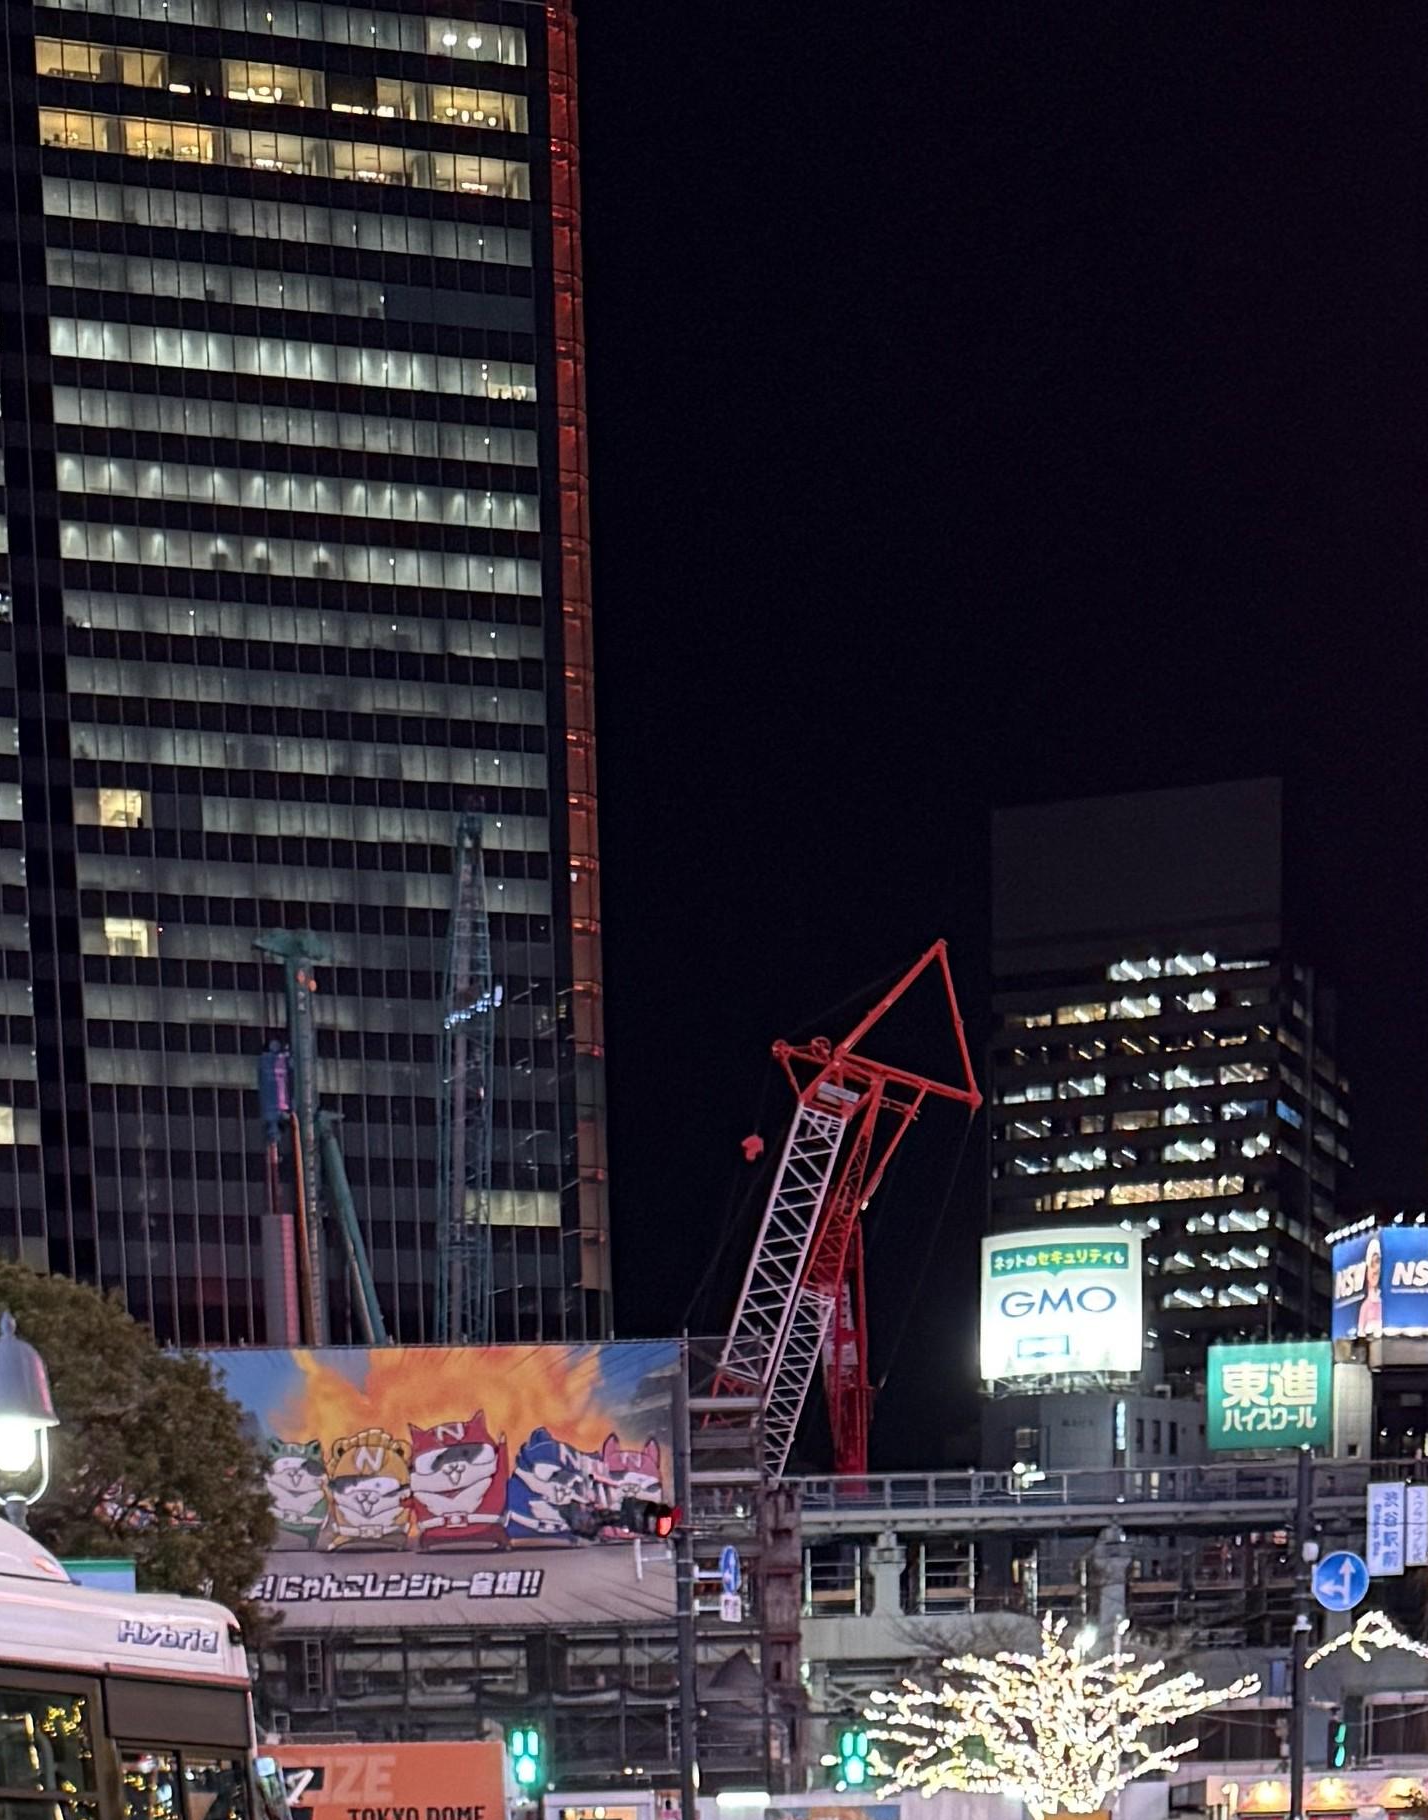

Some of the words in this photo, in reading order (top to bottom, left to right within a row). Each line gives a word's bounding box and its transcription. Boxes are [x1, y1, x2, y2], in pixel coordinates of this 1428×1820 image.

[994, 1249, 1125, 1271] ネットのセキュリティも
[1000, 1286, 1117, 1318] GMO
[1222, 1361, 1318, 1408] 東進
[1222, 1407, 1318, 1432] ハイスクール
[118, 1620, 219, 1654] Hybrid
